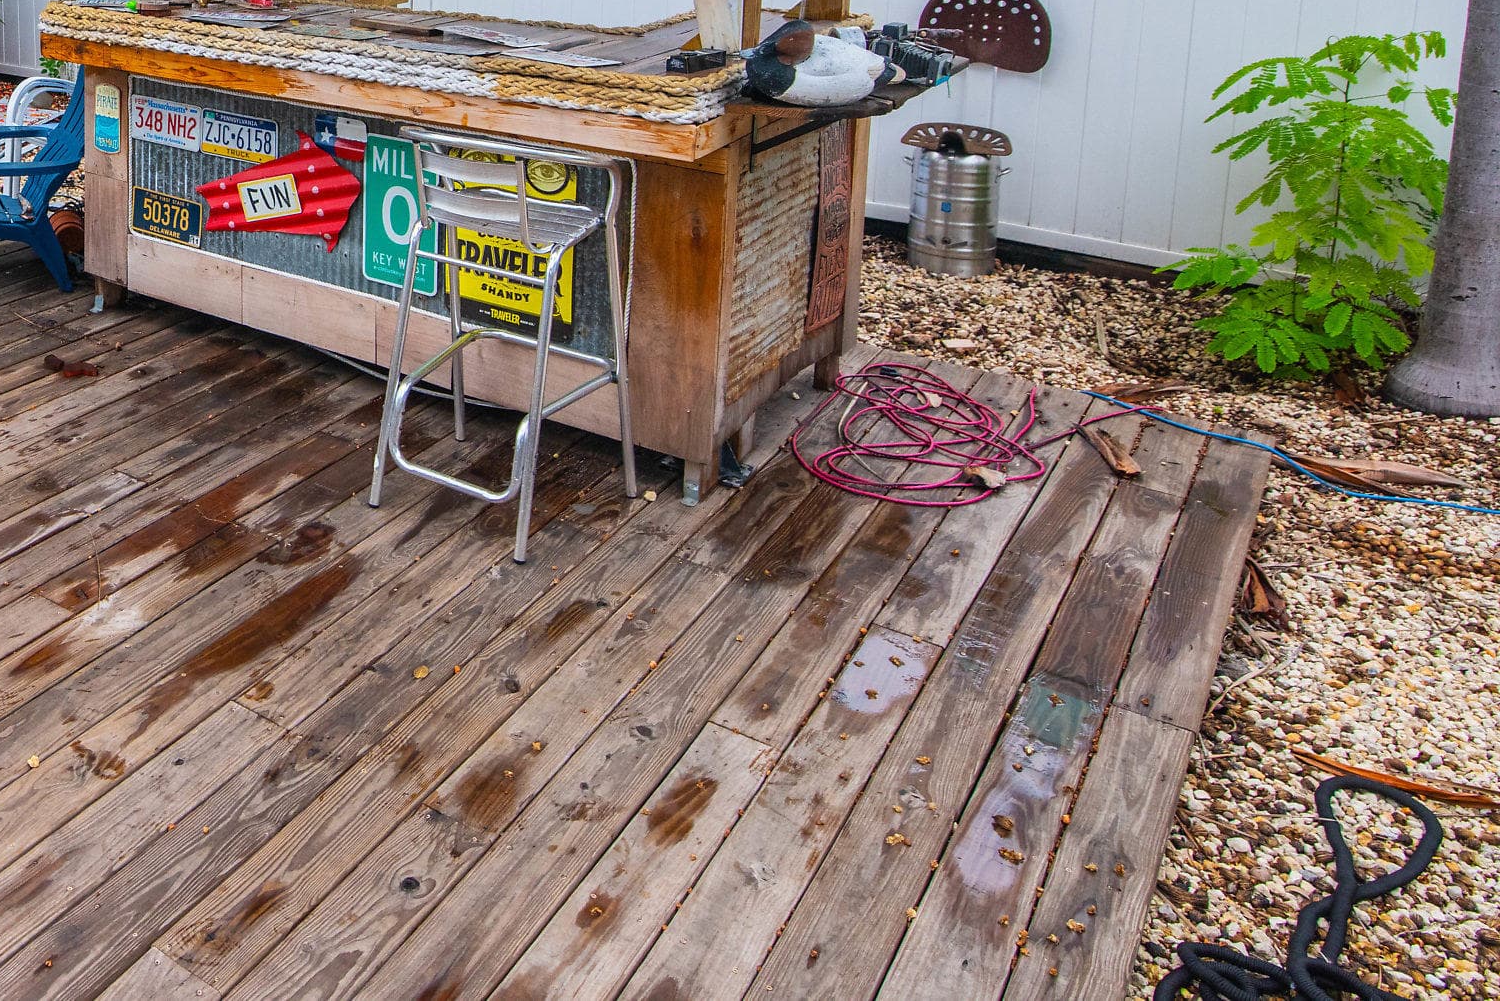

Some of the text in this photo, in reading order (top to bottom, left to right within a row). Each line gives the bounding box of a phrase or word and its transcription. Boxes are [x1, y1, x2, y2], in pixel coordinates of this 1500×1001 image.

[135, 106, 197, 140] 348 NH2
[220, 114, 258, 127] PENNSYLVANIA
[227, 148, 250, 159] TRUCK
[372, 145, 429, 184] MIL
[246, 181, 292, 214] FUN
[143, 197, 190, 232] 50378
[149, 224, 181, 239] DELAWARE
[372, 251, 393, 267] KEY
[398, 256, 427, 276] WST
[481, 282, 531, 303] SHANDY
[490, 308, 520, 326] TRAVELER
